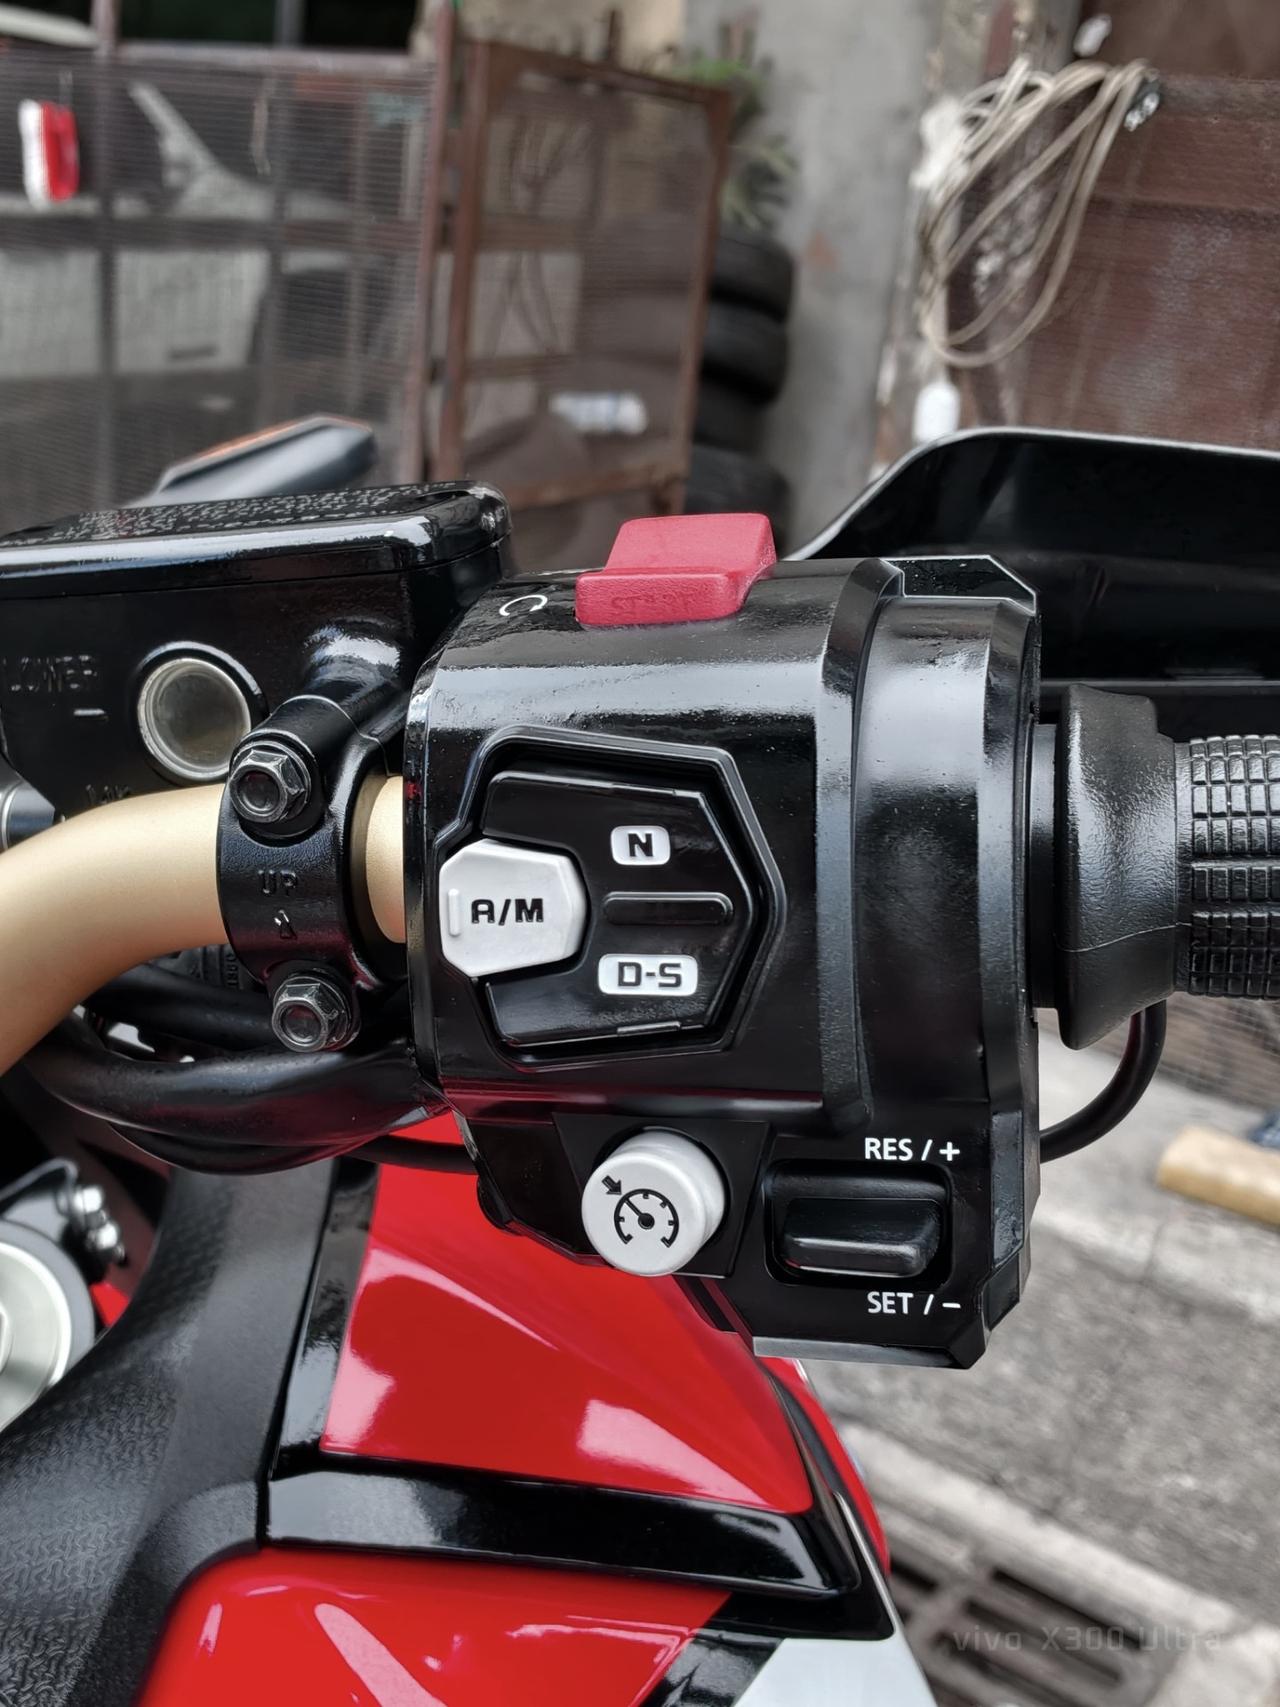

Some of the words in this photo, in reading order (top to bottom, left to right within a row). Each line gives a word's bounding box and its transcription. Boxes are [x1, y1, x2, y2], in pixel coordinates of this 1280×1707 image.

[627, 833, 654, 857] N
[259, 869, 297, 896] UP
[471, 898, 544, 926] A/M
[617, 961, 682, 988] D-S
[864, 1137, 913, 1161] RES
[921, 1139, 933, 1161] /
[867, 1291, 914, 1315] SET
[923, 1294, 934, 1315] /
